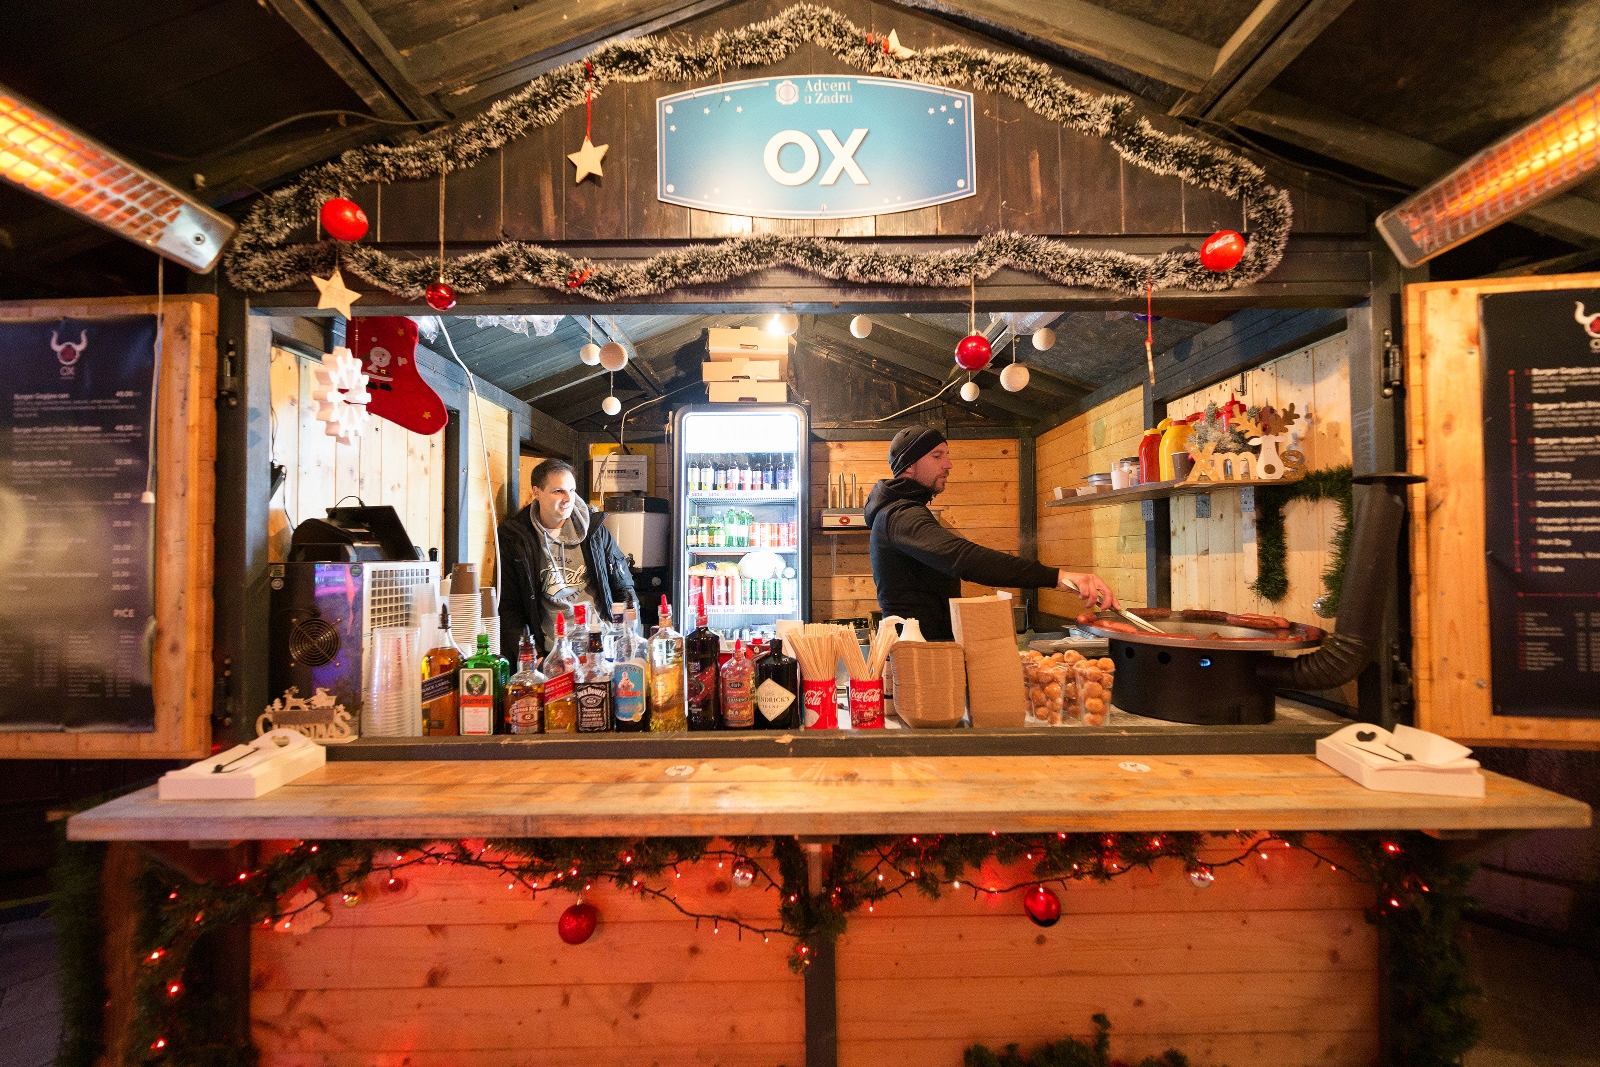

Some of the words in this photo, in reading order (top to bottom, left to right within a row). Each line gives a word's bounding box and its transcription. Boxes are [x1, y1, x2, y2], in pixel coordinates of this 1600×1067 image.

[804, 79, 851, 92] Advent
[804, 94, 812, 104] u
[815, 91, 853, 105] Zadru
[763, 128, 870, 186] OX
[59, 366, 75, 376] OX
